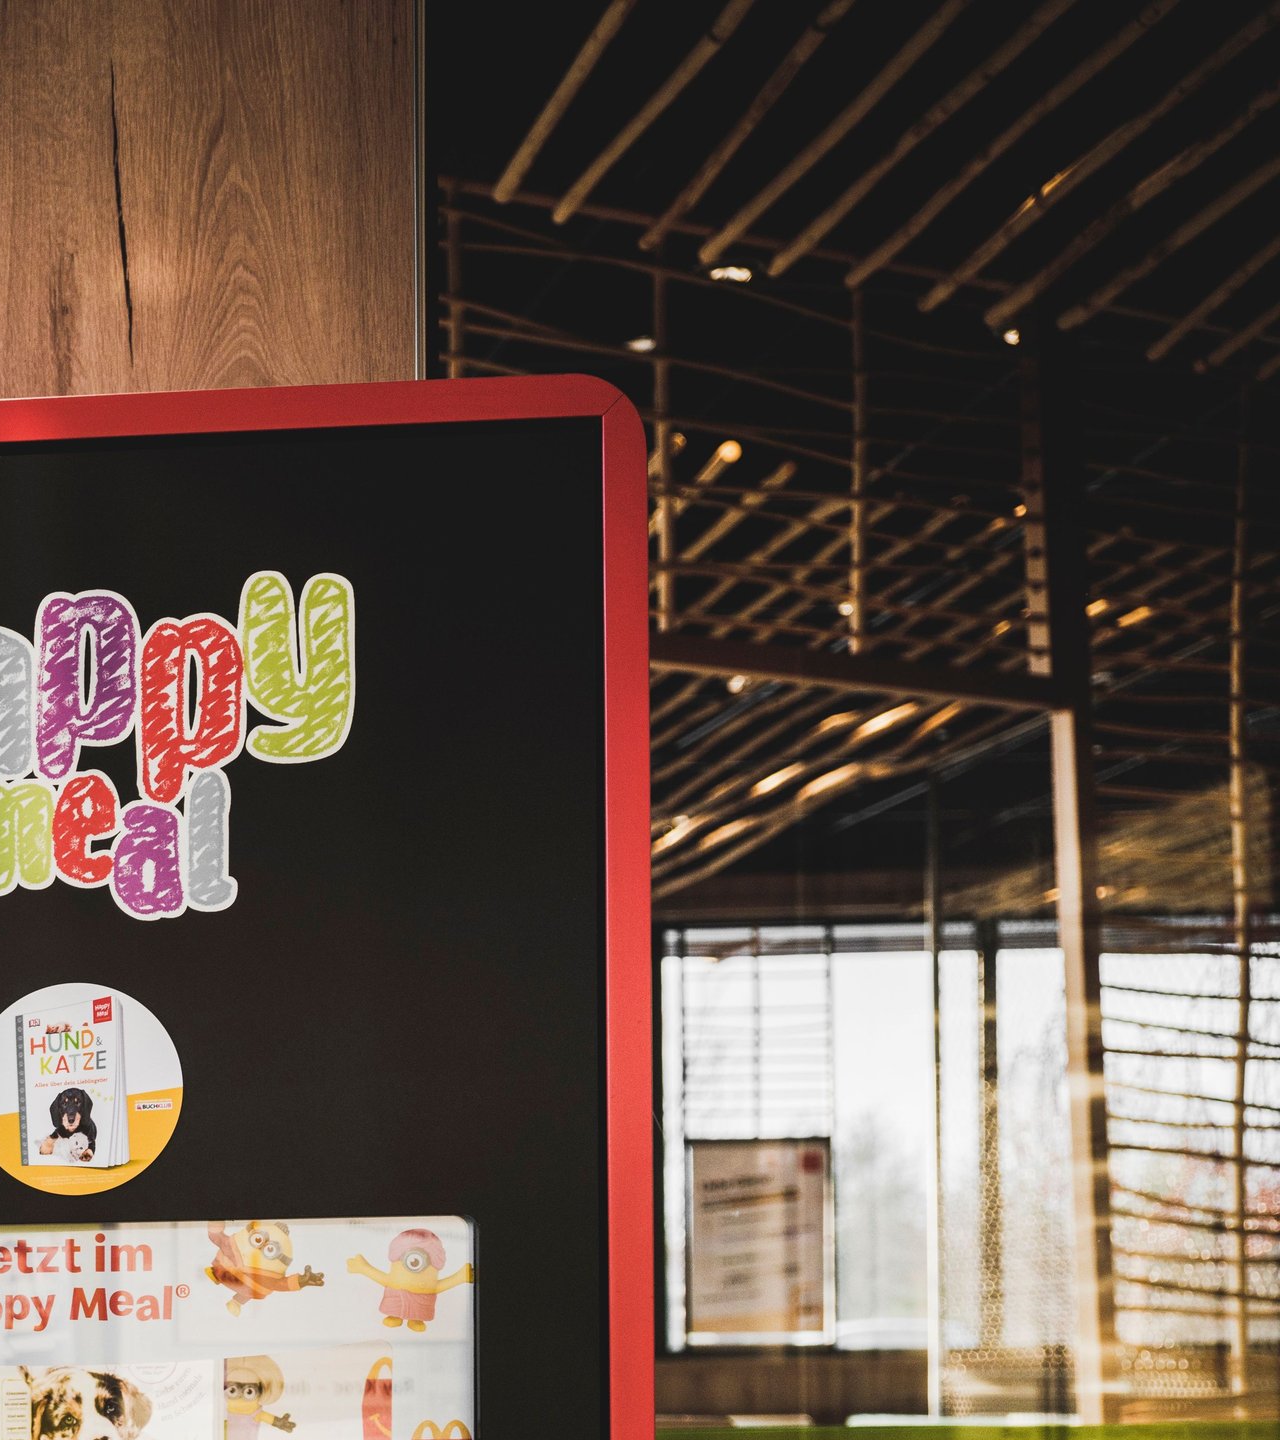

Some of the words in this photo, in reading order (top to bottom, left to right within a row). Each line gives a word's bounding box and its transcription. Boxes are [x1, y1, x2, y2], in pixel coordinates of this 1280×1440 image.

[30, 1029, 95, 1056] HUND
[95, 1036, 104, 1046] &
[40, 1050, 107, 1076] KATZE
[95, 1233, 153, 1273] im
